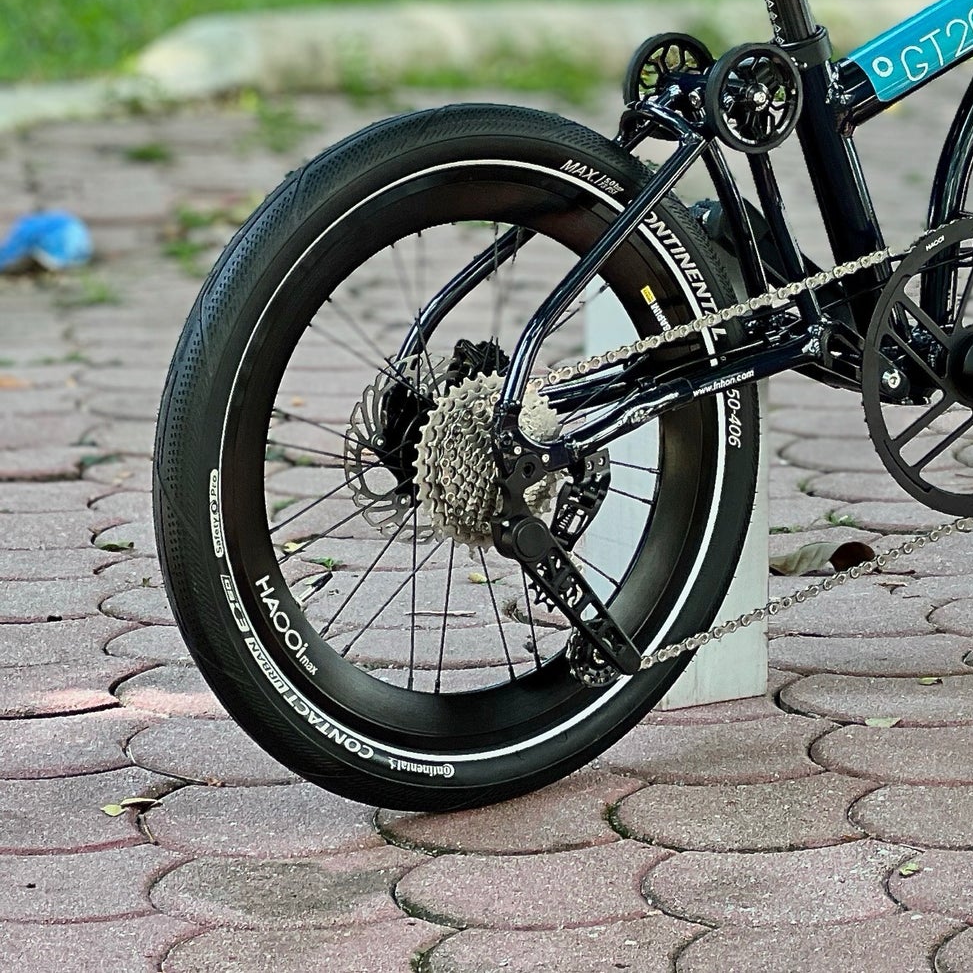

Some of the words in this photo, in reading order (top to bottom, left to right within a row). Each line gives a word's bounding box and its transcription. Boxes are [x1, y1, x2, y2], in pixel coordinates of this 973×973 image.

[692, 369, 755, 398] www.fnhon.com
[726, 388, 742, 449] 50-406
[210, 474, 218, 496] Pro
[213, 517, 223, 554] Safety
[248, 639, 289, 694] URBAN
[299, 654, 318, 676] max
[283, 693, 375, 759] CONTACT
